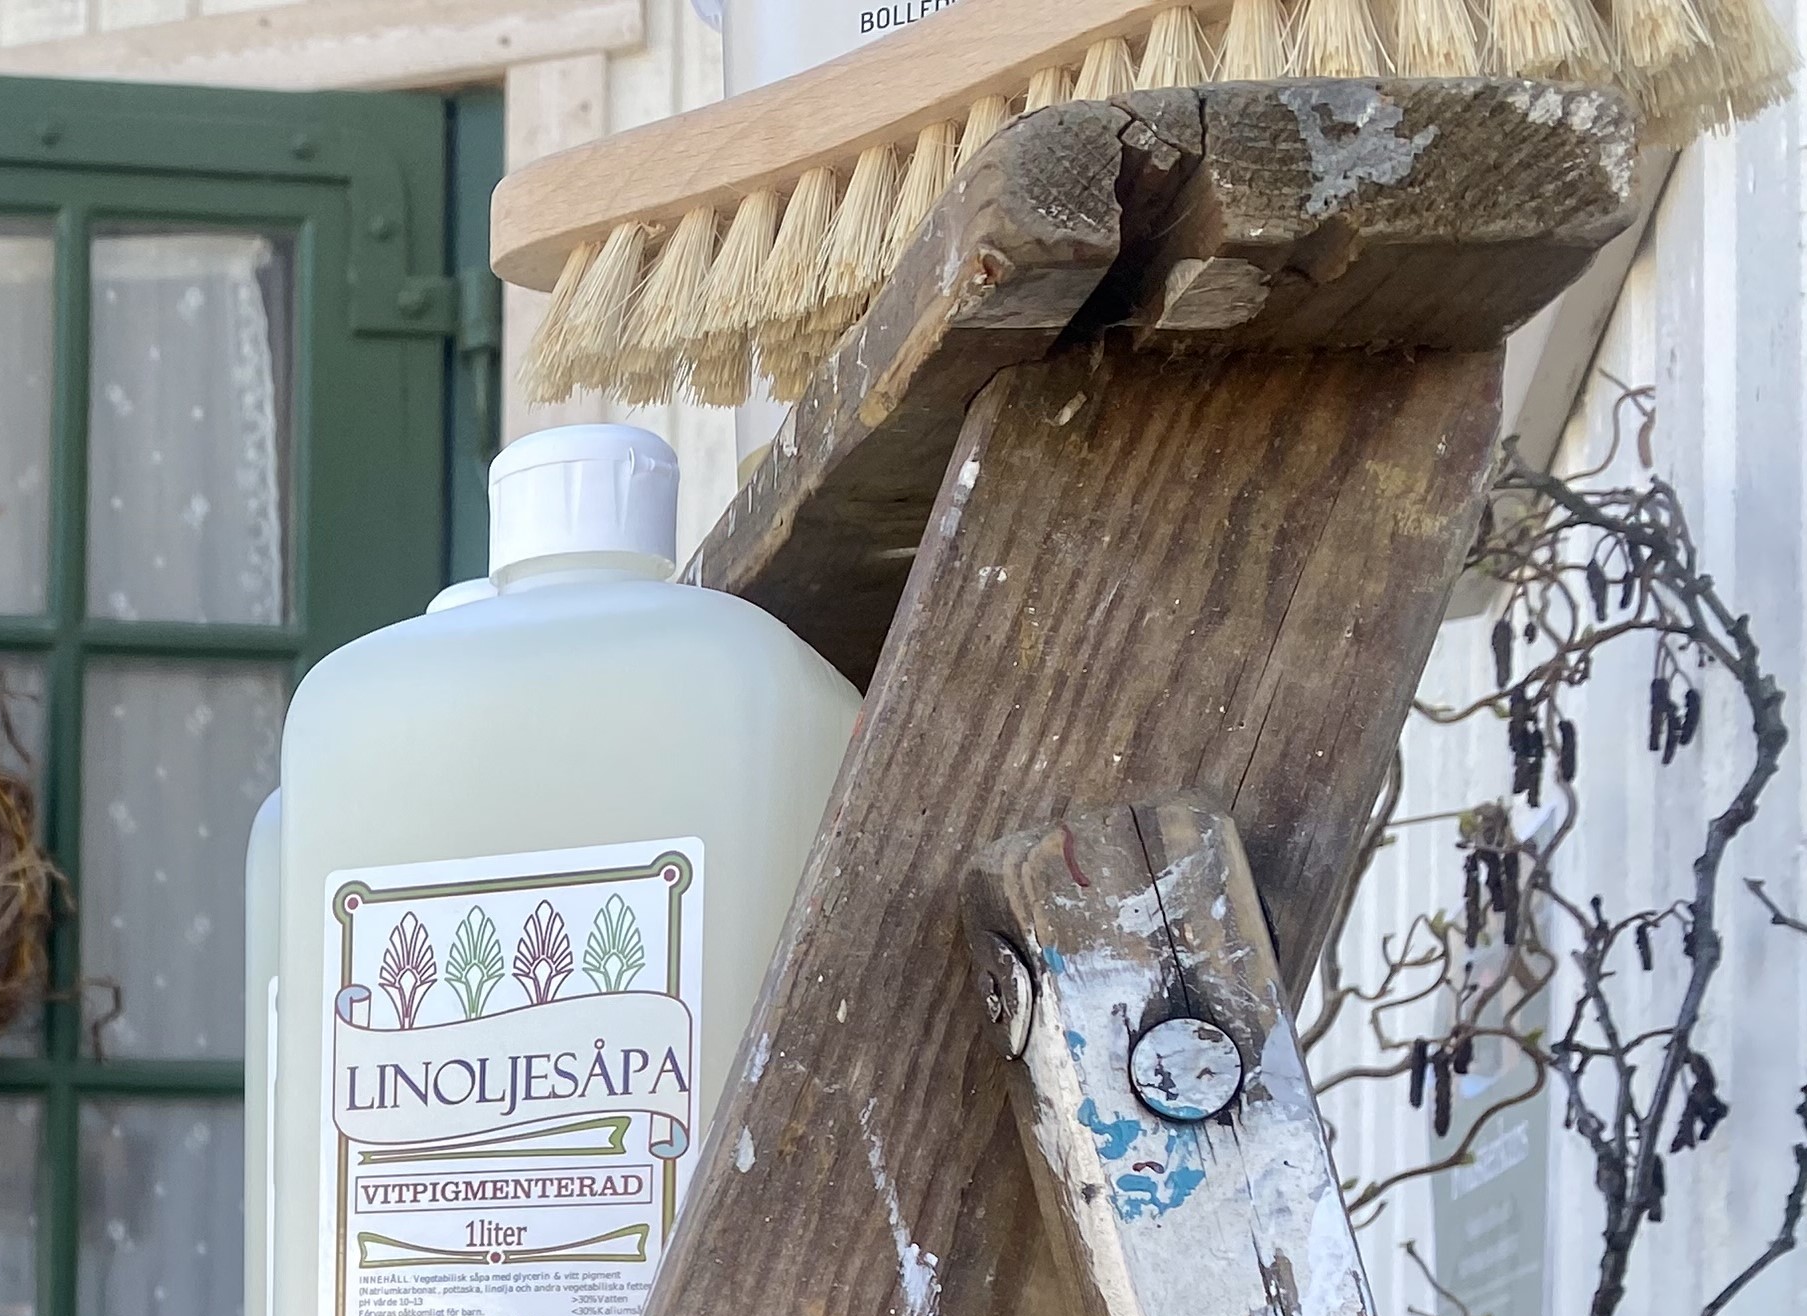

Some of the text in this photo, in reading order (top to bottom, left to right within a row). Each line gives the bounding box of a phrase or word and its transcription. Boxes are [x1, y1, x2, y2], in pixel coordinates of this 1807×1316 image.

[346, 1038, 689, 1116] LINOLJESÅPA
[361, 1174, 643, 1205] VITPIGMENTERAD
[413, 1274, 466, 1285] Vegetabilisk
[469, 1272, 490, 1283] såpa
[492, 1272, 511, 1281] med
[513, 1272, 550, 1283] glycerin
[554, 1272, 561, 1280] &
[564, 1271, 580, 1280] vitt
[582, 1271, 621, 1282] pigment
[515, 1284, 531, 1292] och
[534, 1284, 561, 1292] andra
[564, 1283, 624, 1294] vegetabiliska
[359, 1298, 370, 1308] pH
